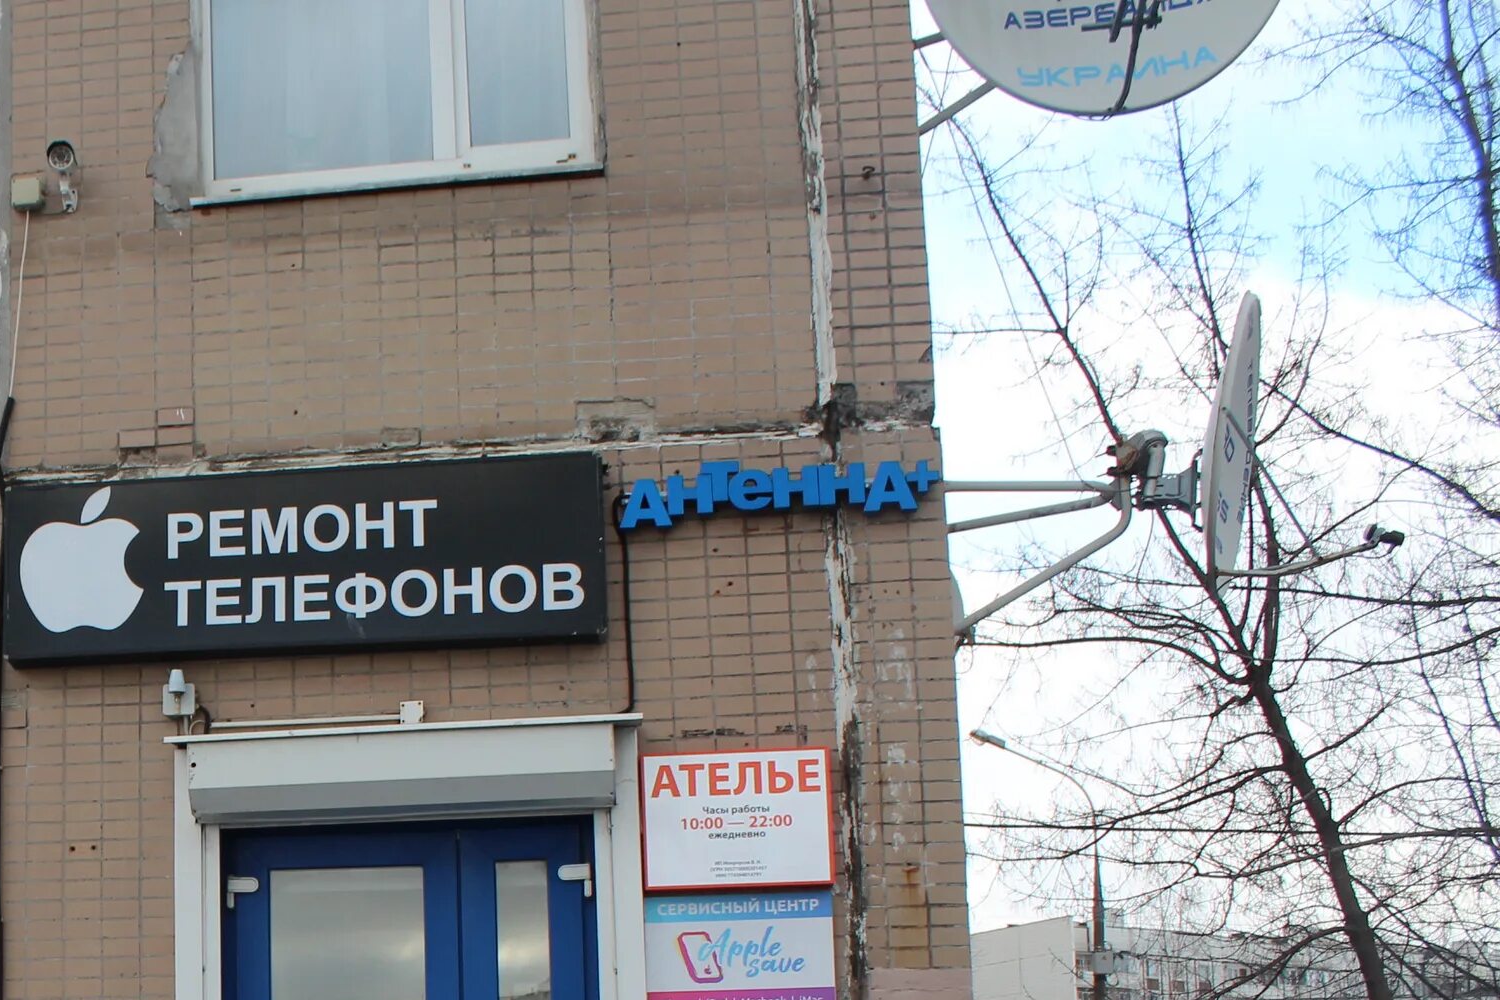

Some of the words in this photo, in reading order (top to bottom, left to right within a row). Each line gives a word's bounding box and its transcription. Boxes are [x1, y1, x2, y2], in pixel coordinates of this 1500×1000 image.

[1016, 45, 1220, 88] УКРАИНА
[166, 498, 438, 560] РЕМОНТ
[163, 561, 586, 627] ТЕЛЕФОНОВ
[651, 758, 822, 799] АТЕЛЬЕ
[681, 816, 724, 831] 10:00
[749, 814, 793, 829] 22:00
[702, 806, 729, 815] Часы
[731, 804, 770, 816] работы
[708, 830, 767, 841] ежедневно
[657, 898, 760, 917] СЕРВИСНЫЙ
[764, 898, 820, 916] ЦЕНТР
[697, 926, 783, 968] Apple
[746, 957, 806, 978] save
